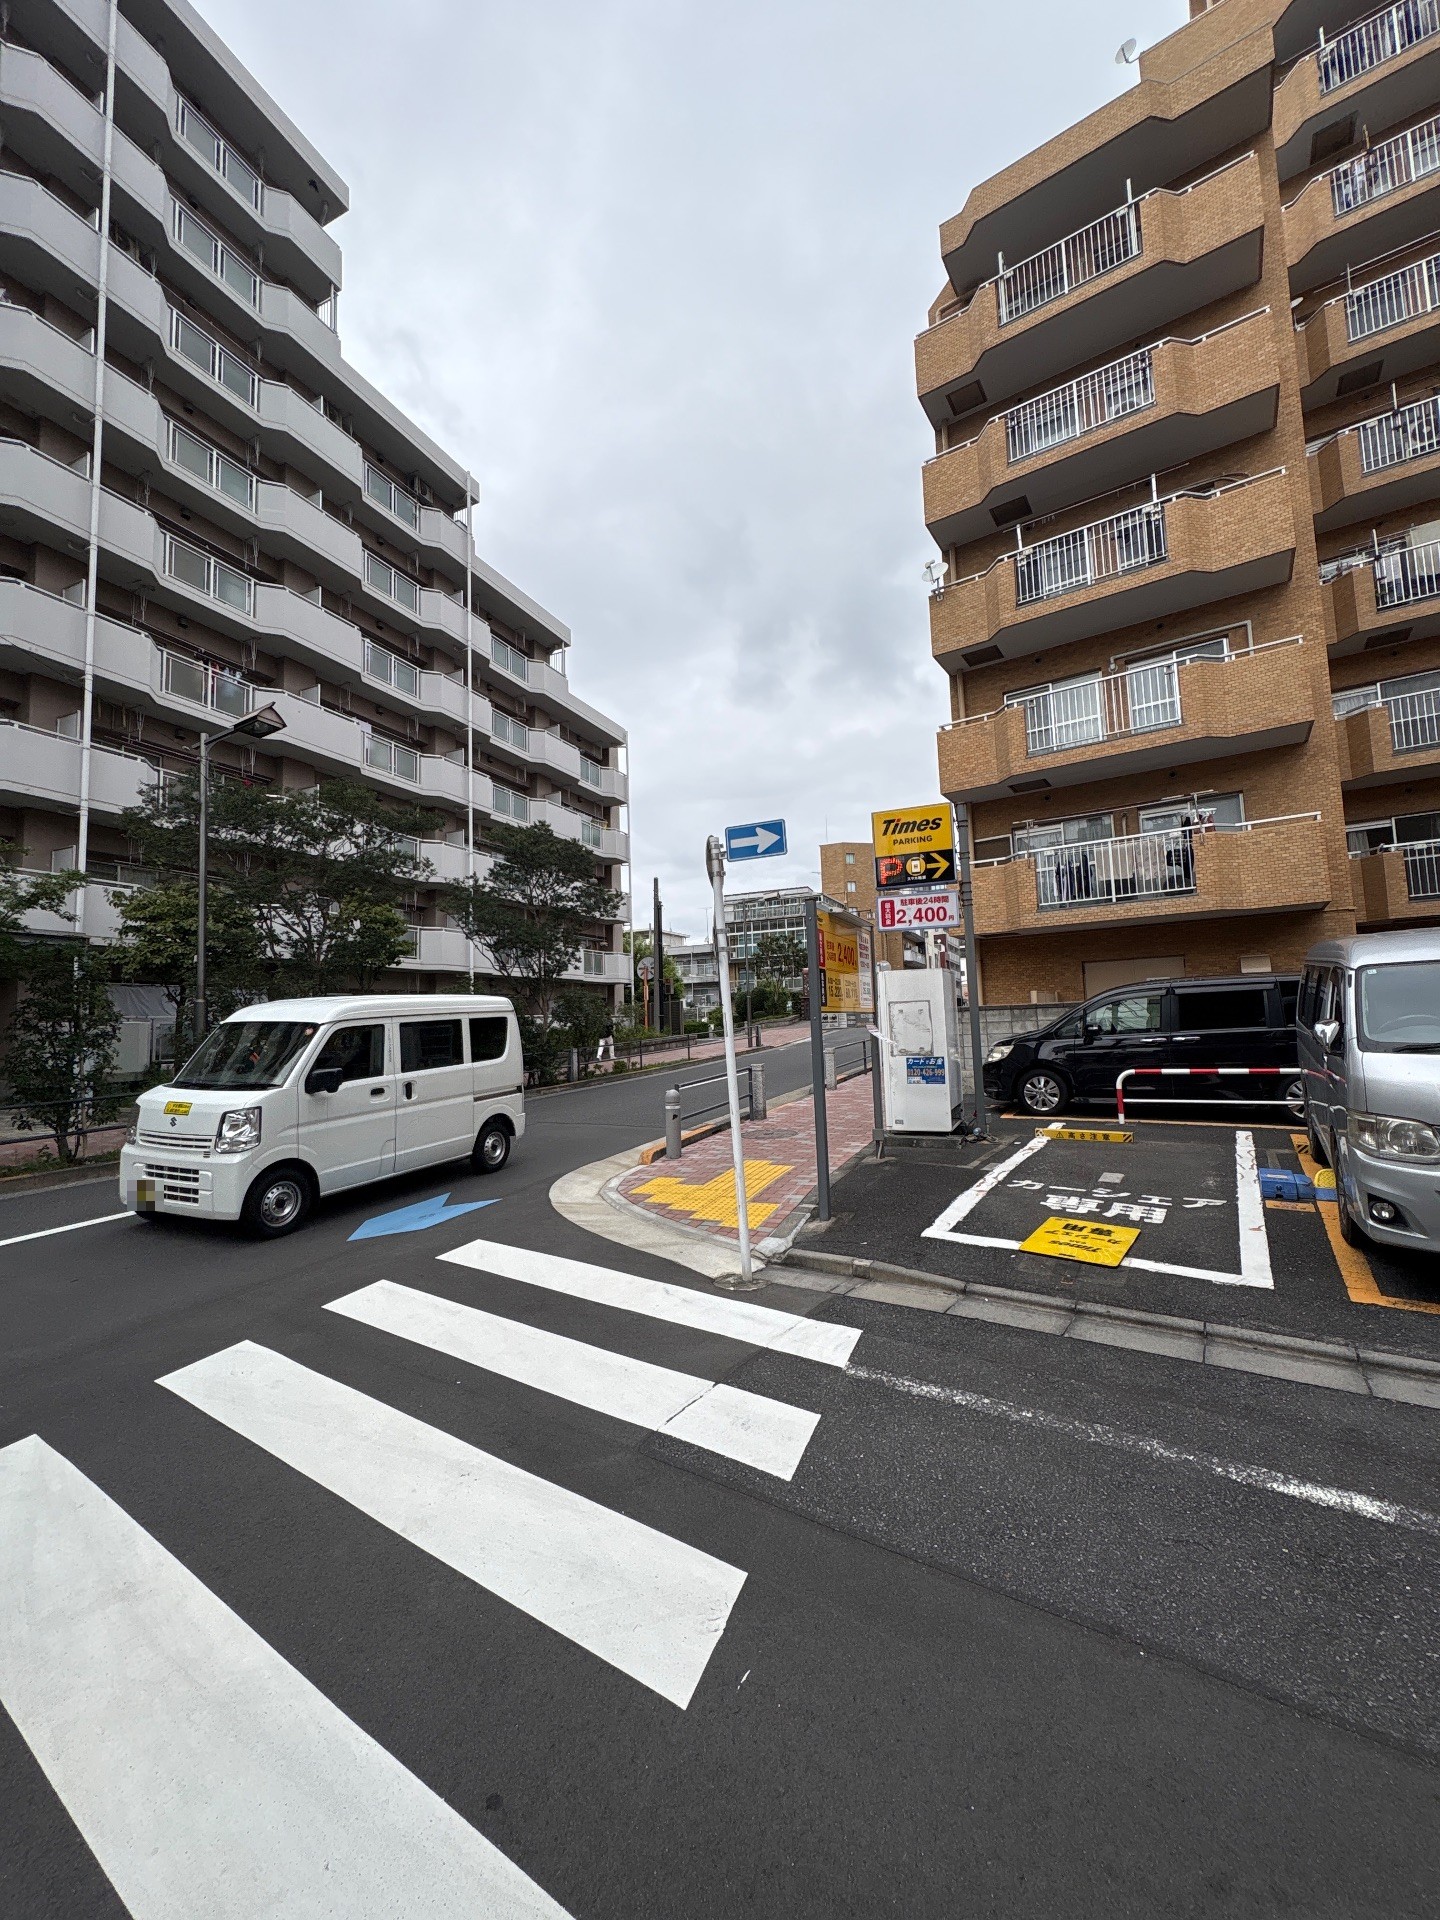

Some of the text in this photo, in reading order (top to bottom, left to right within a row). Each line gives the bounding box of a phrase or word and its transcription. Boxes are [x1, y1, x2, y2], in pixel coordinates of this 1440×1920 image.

[882, 817, 943, 836] Times
[893, 834, 933, 846] PARKING
[880, 857, 903, 885] P
[900, 895, 950, 907] 駐車後24時間
[1068, 1131, 1110, 1141] 高さ注意
[1007, 1179, 1227, 1208] カーシェア
[1040, 1194, 1168, 1224] 専用
[1061, 1223, 1116, 1237] 専用
[1048, 1240, 1102, 1252] Times
